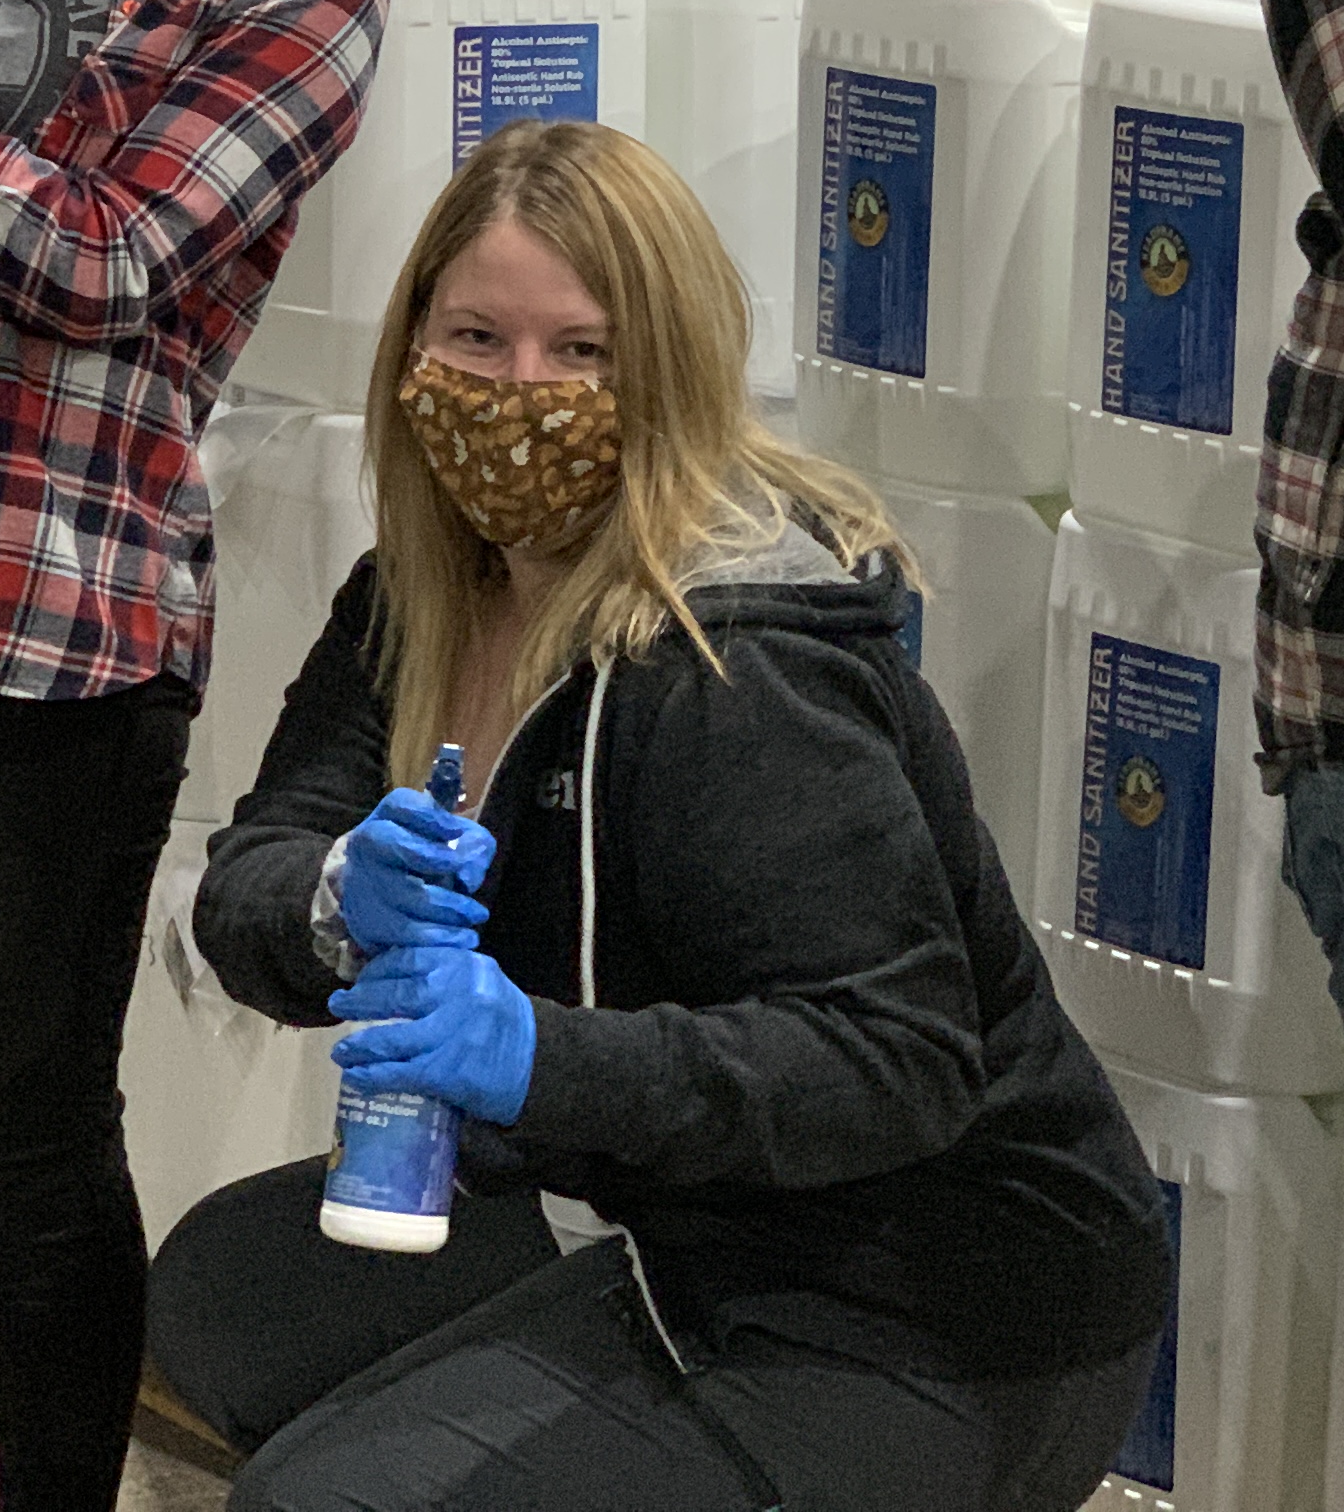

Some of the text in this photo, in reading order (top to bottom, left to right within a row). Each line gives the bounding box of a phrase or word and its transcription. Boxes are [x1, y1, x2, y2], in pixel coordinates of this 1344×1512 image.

[491, 35, 589, 47] Alcohol Antiseptic
[490, 48, 512, 57] 80%
[491, 57, 579, 69] Topical Solution
[491, 70, 584, 83] Antiseptic Hand Rub
[544, 82, 582, 92] Solution
[518, 96, 529, 106] (5
[532, 94, 554, 106] gal.)
[818, 79, 844, 352] HAND SANITIZER
[1105, 120, 1135, 409] HAND SANITIZER
[1078, 647, 1112, 932] HAND SANITIZER
